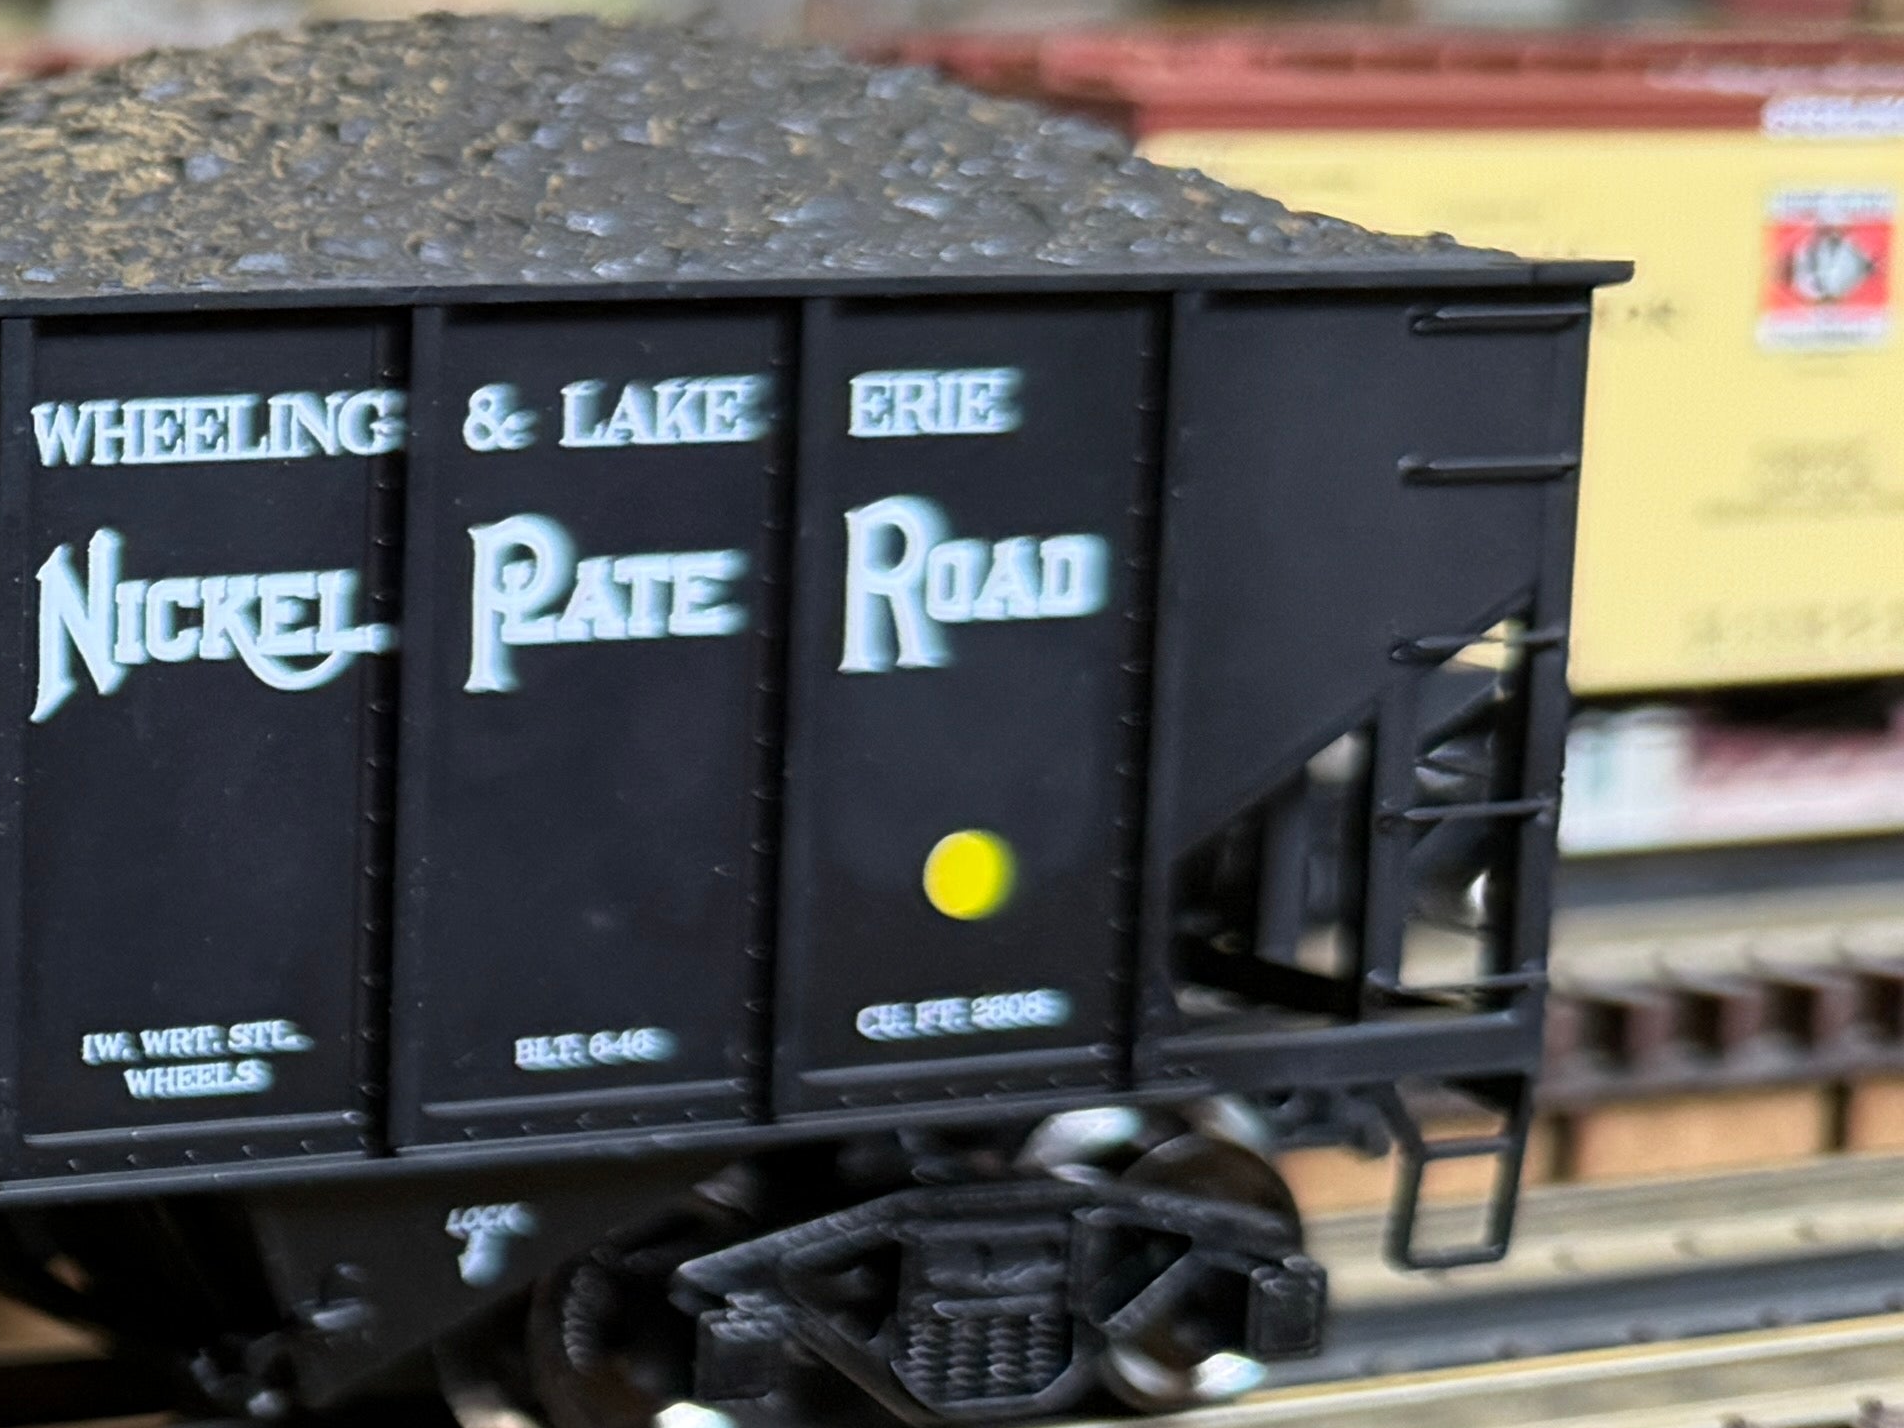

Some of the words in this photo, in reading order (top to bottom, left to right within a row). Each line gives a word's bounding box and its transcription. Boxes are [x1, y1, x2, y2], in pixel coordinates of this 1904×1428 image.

[29, 388, 405, 467] WHEELING
[462, 384, 534, 451] &
[558, 375, 765, 448] LAKE
[847, 368, 1018, 437] ERIE
[29, 527, 397, 723] NICKEL
[463, 512, 747, 692] PLATE
[838, 494, 1108, 673] ROAD
[123, 1058, 274, 1099] WHEELS
[444, 1202, 534, 1237] LOCK
